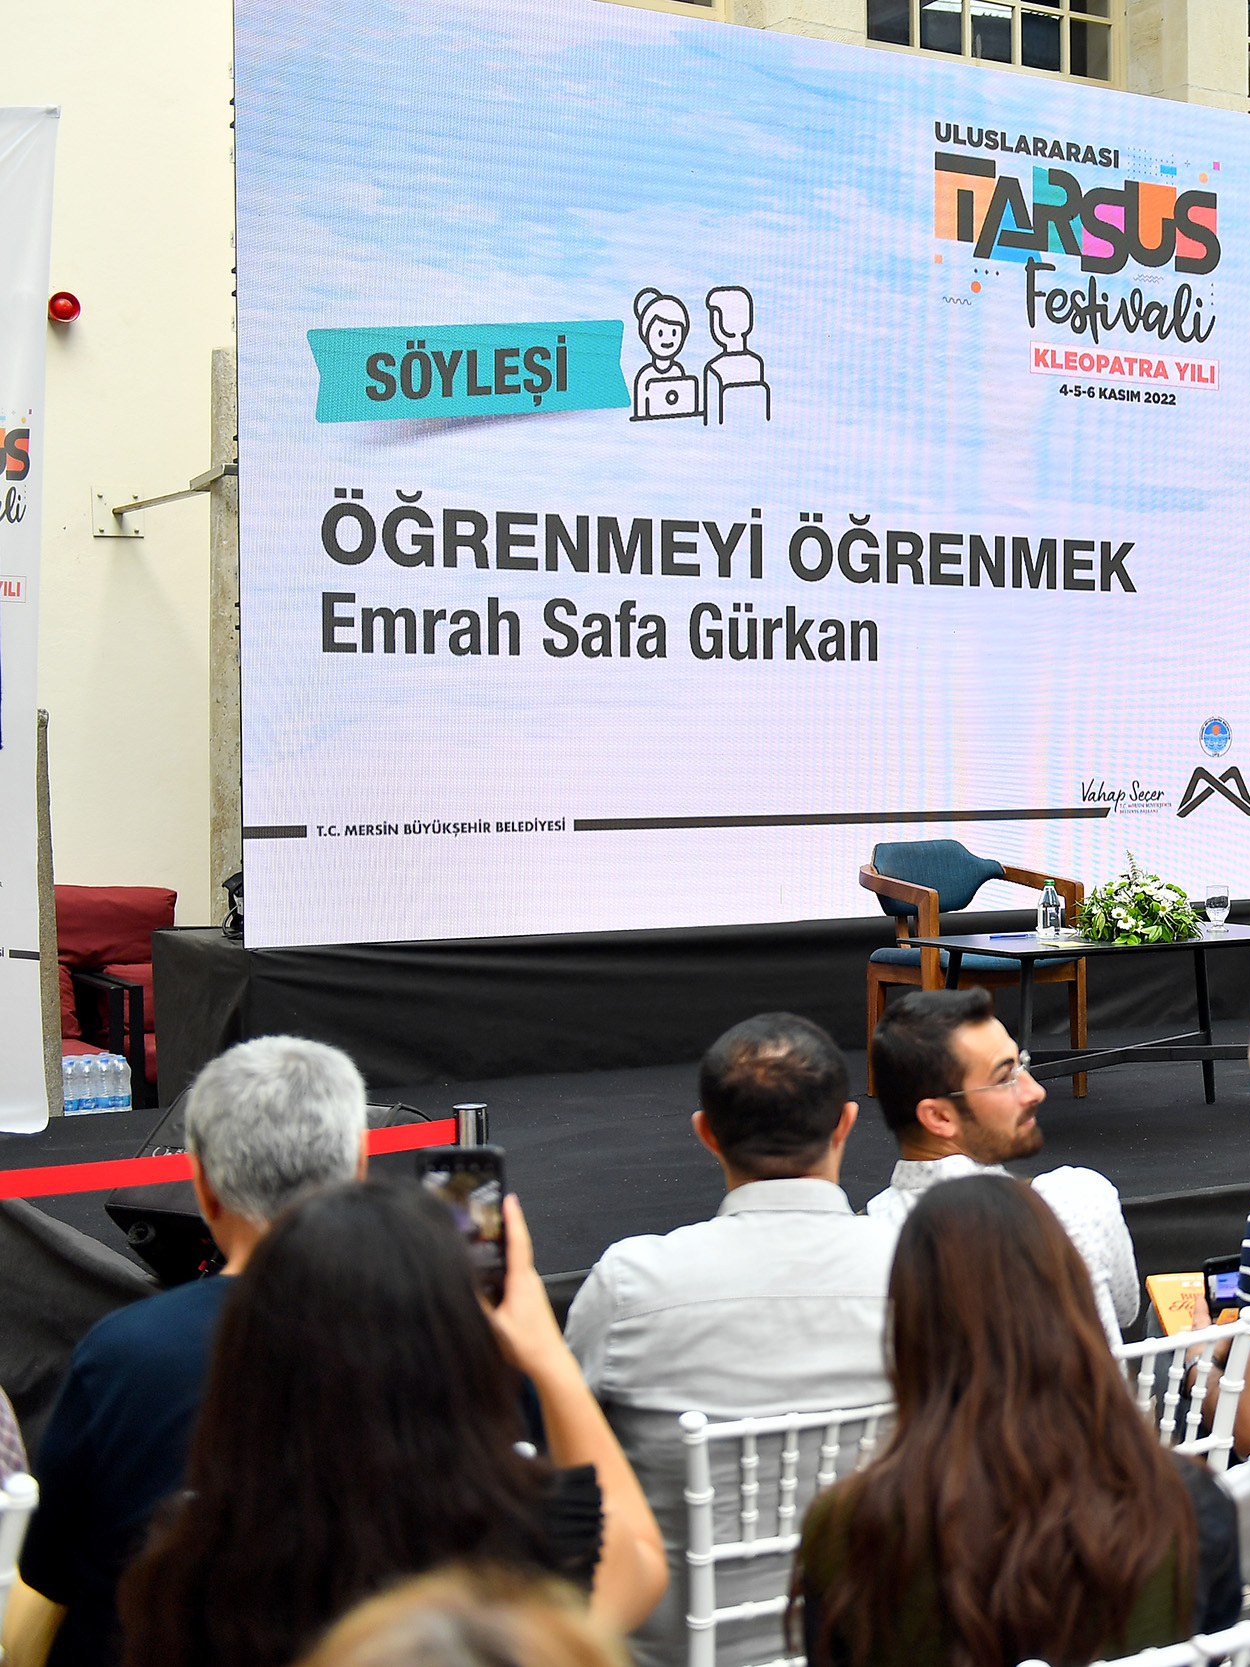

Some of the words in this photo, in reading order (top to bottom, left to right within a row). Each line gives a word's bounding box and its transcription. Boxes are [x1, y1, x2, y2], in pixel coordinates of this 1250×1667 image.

[935, 121, 1120, 169] ULUSLARARASI
[934, 151, 1221, 275] TARSUS
[1025, 256, 1216, 344] Festivali
[365, 335, 568, 407] SÖYLEŞİ
[1034, 348, 1169, 379] KLEOPATRA
[1175, 362, 1215, 384] YILI
[1059, 385, 1095, 399] 4-5-6
[1098, 387, 1142, 403] KASIM
[1144, 391, 1177, 405] 2022
[321, 488, 763, 580] ÖĞRENMEYİ
[788, 514, 1137, 593] ÖĞRENMEK
[321, 592, 521, 657] Emrah
[543, 598, 667, 660] Safa
[690, 602, 880, 663] Gürkan
[1081, 778, 1125, 813] Vahap
[317, 825, 340, 837] T.C.
[344, 822, 399, 836] MERSİN
[404, 819, 491, 838] BÜYÜKŞEHİR
[495, 817, 566, 833] BELEDİYESİ
